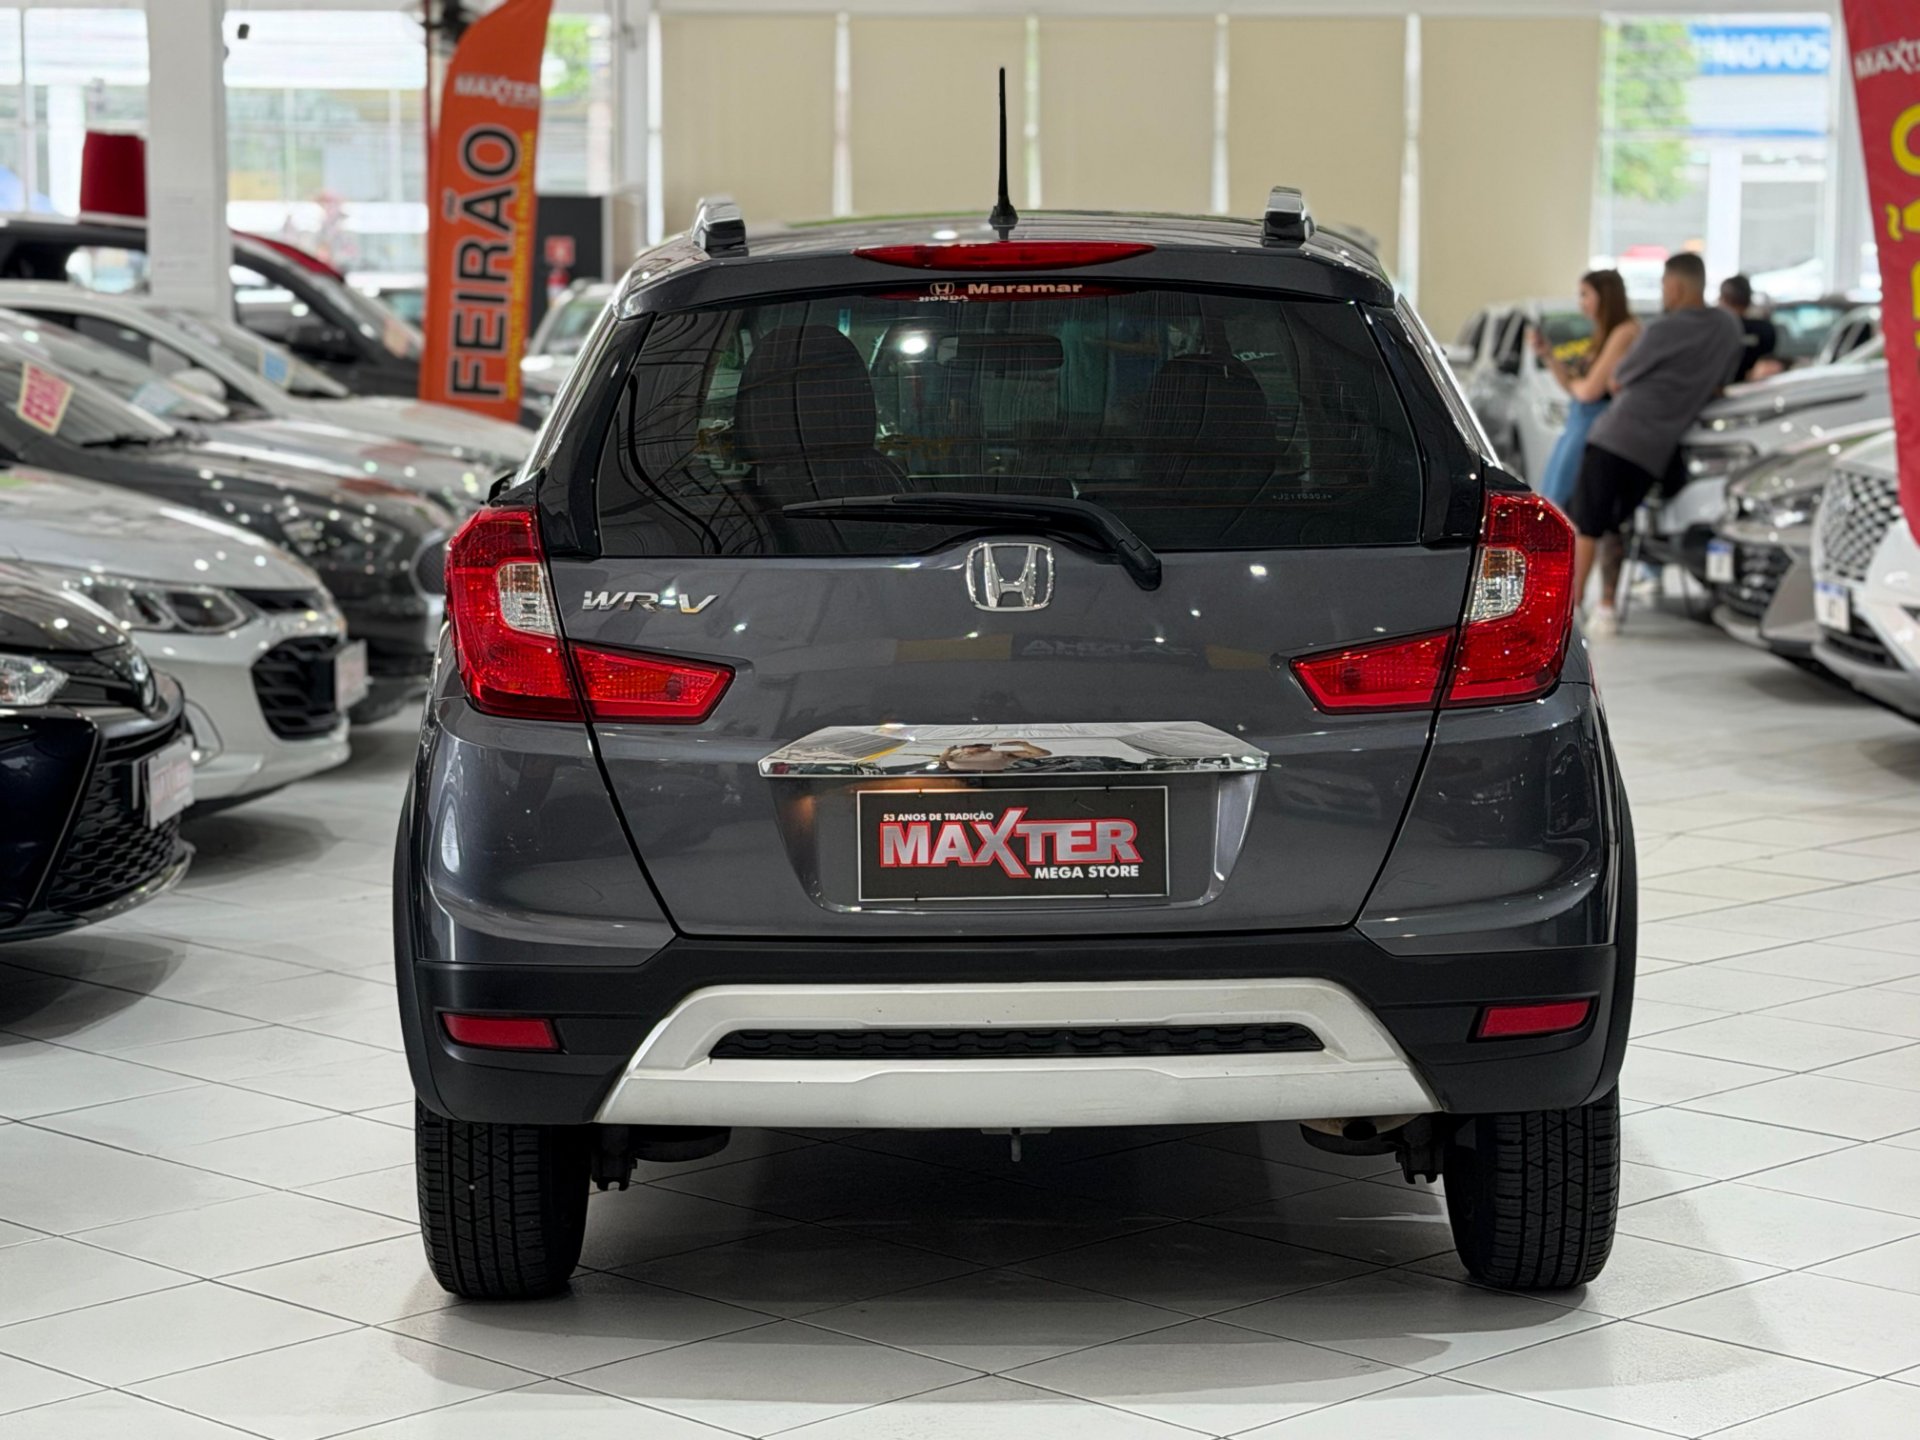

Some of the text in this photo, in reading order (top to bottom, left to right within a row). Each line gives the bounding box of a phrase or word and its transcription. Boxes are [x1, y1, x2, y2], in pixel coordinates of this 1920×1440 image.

[1855, 37, 1920, 79] MAXT
[444, 124, 522, 398] FEIRÃO
[967, 283, 1083, 295] Maramar
[582, 591, 719, 614] WR-V
[883, 813, 895, 822] 53
[897, 813, 926, 821] ANOS
[929, 813, 942, 821] DE
[880, 807, 1143, 878] MAXTER
[1034, 865, 1139, 879] MEGA STORE
